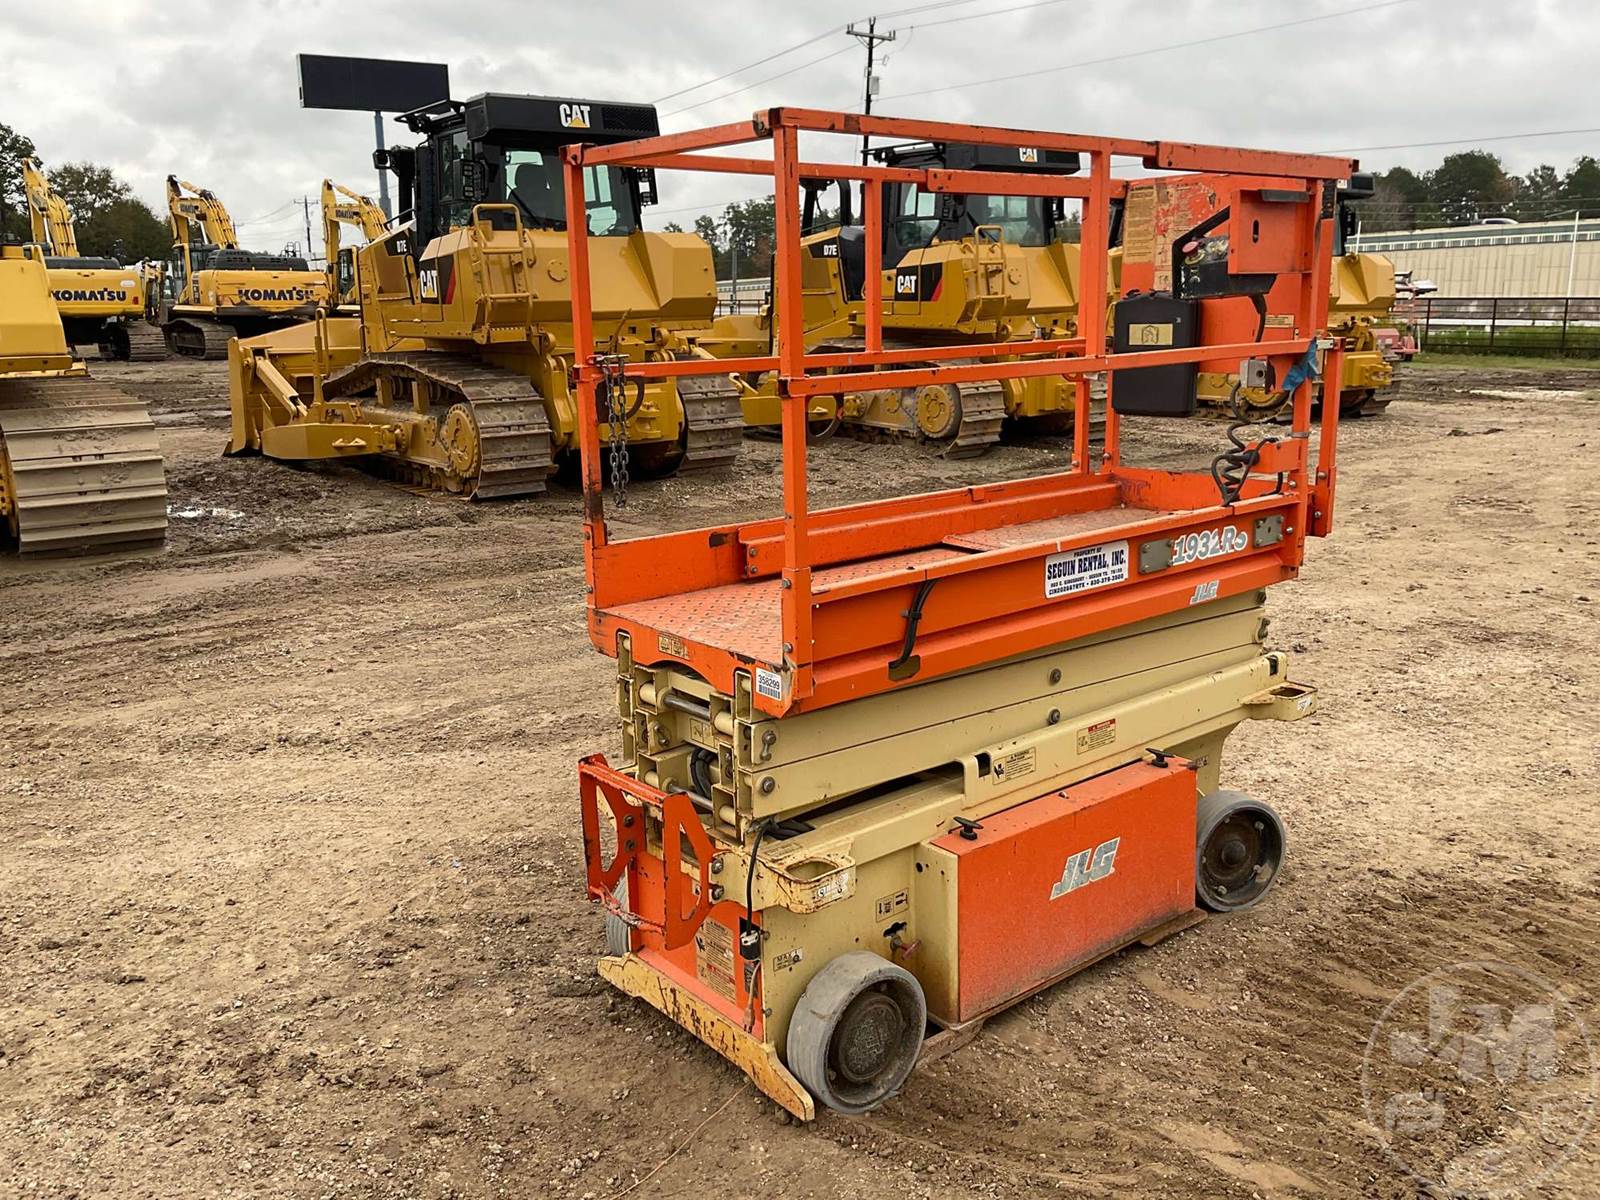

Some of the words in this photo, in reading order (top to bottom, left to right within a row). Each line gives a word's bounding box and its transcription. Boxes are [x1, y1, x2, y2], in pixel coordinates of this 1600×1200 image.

[559, 103, 590, 129] CAT
[823, 244, 838, 256] D7E
[51, 287, 127, 302] KOMATSU
[237, 286, 315, 301] KOMATSU
[420, 269, 438, 298] CAT
[897, 275, 917, 294] CAT
[1047, 559, 1076, 581] SEGUIN
[1078, 553, 1110, 574] RENTAL,
[1111, 549, 1127, 566] INC.
[1189, 579, 1219, 605] JLG
[1049, 836, 1121, 900] JLG
